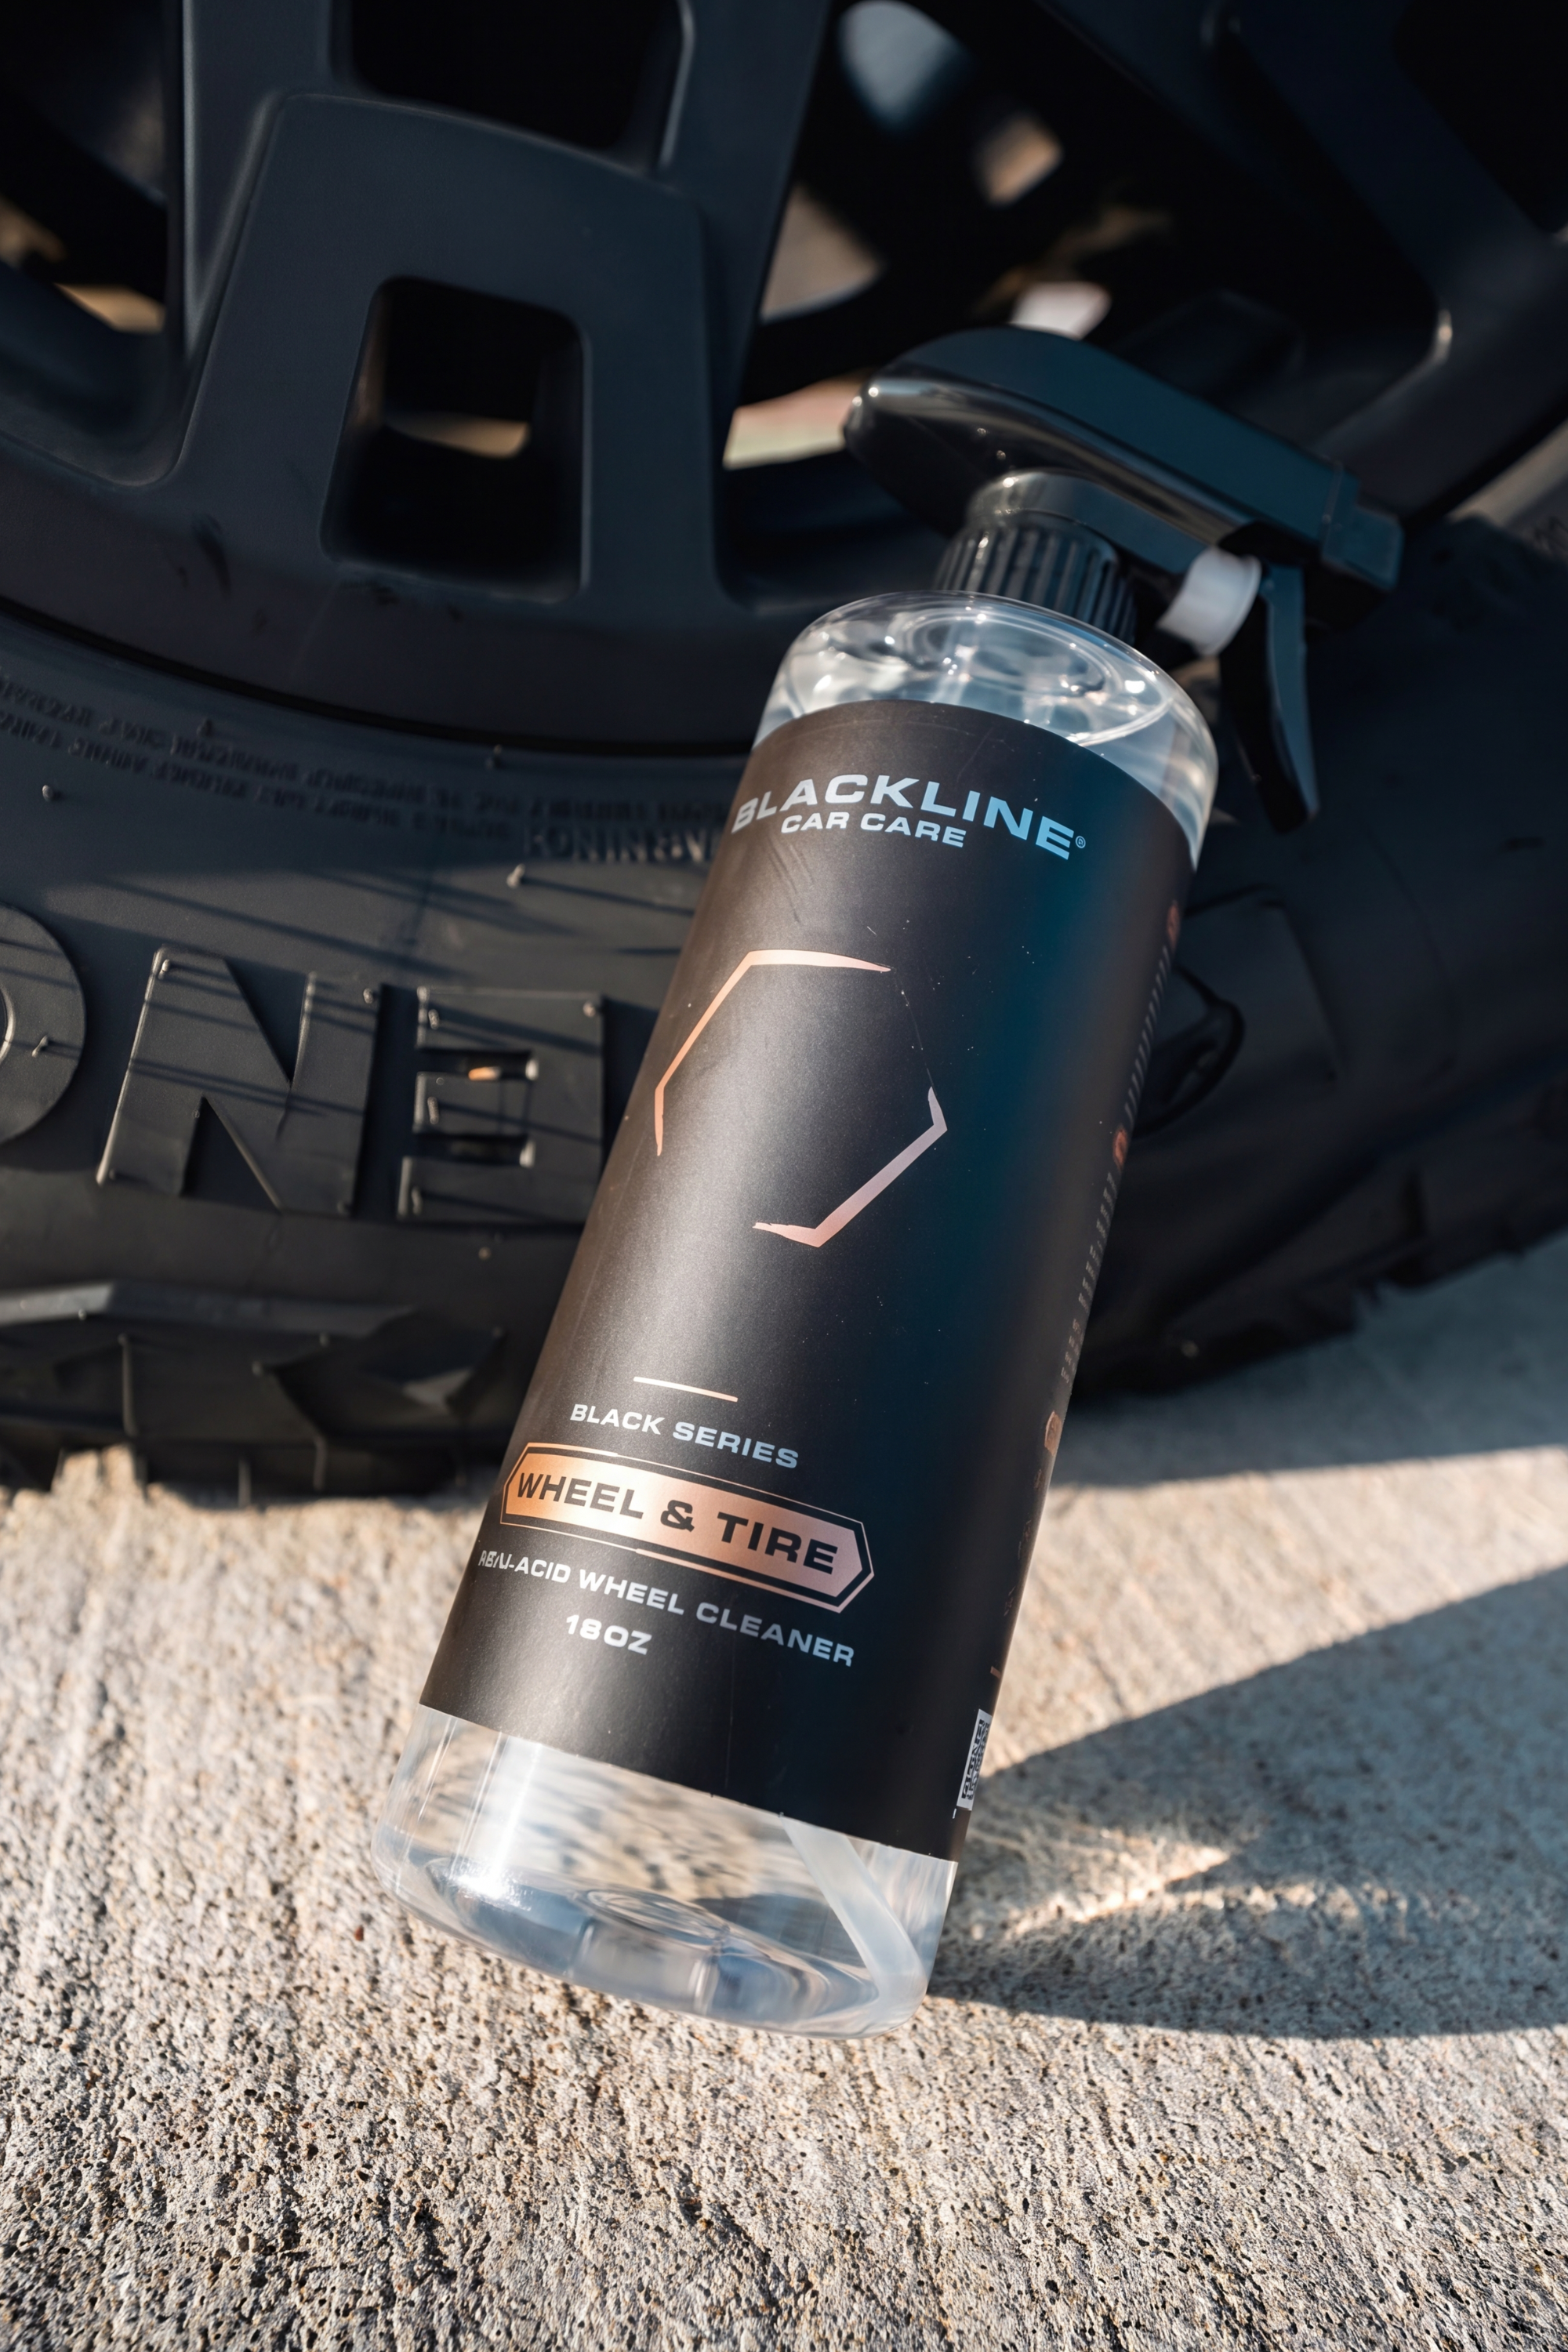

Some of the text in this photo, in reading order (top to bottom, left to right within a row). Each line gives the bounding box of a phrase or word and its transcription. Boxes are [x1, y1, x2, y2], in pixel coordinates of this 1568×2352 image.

[781, 811, 967, 848] CAR CARE
[570, 1403, 798, 1468] BLACK SERIES
[517, 1472, 839, 1575] WHEEL & TIRE
[566, 1614, 652, 1655] 18OZ
[579, 1569, 684, 1615] WHEEL
[695, 1602, 855, 1667] CLEANER
